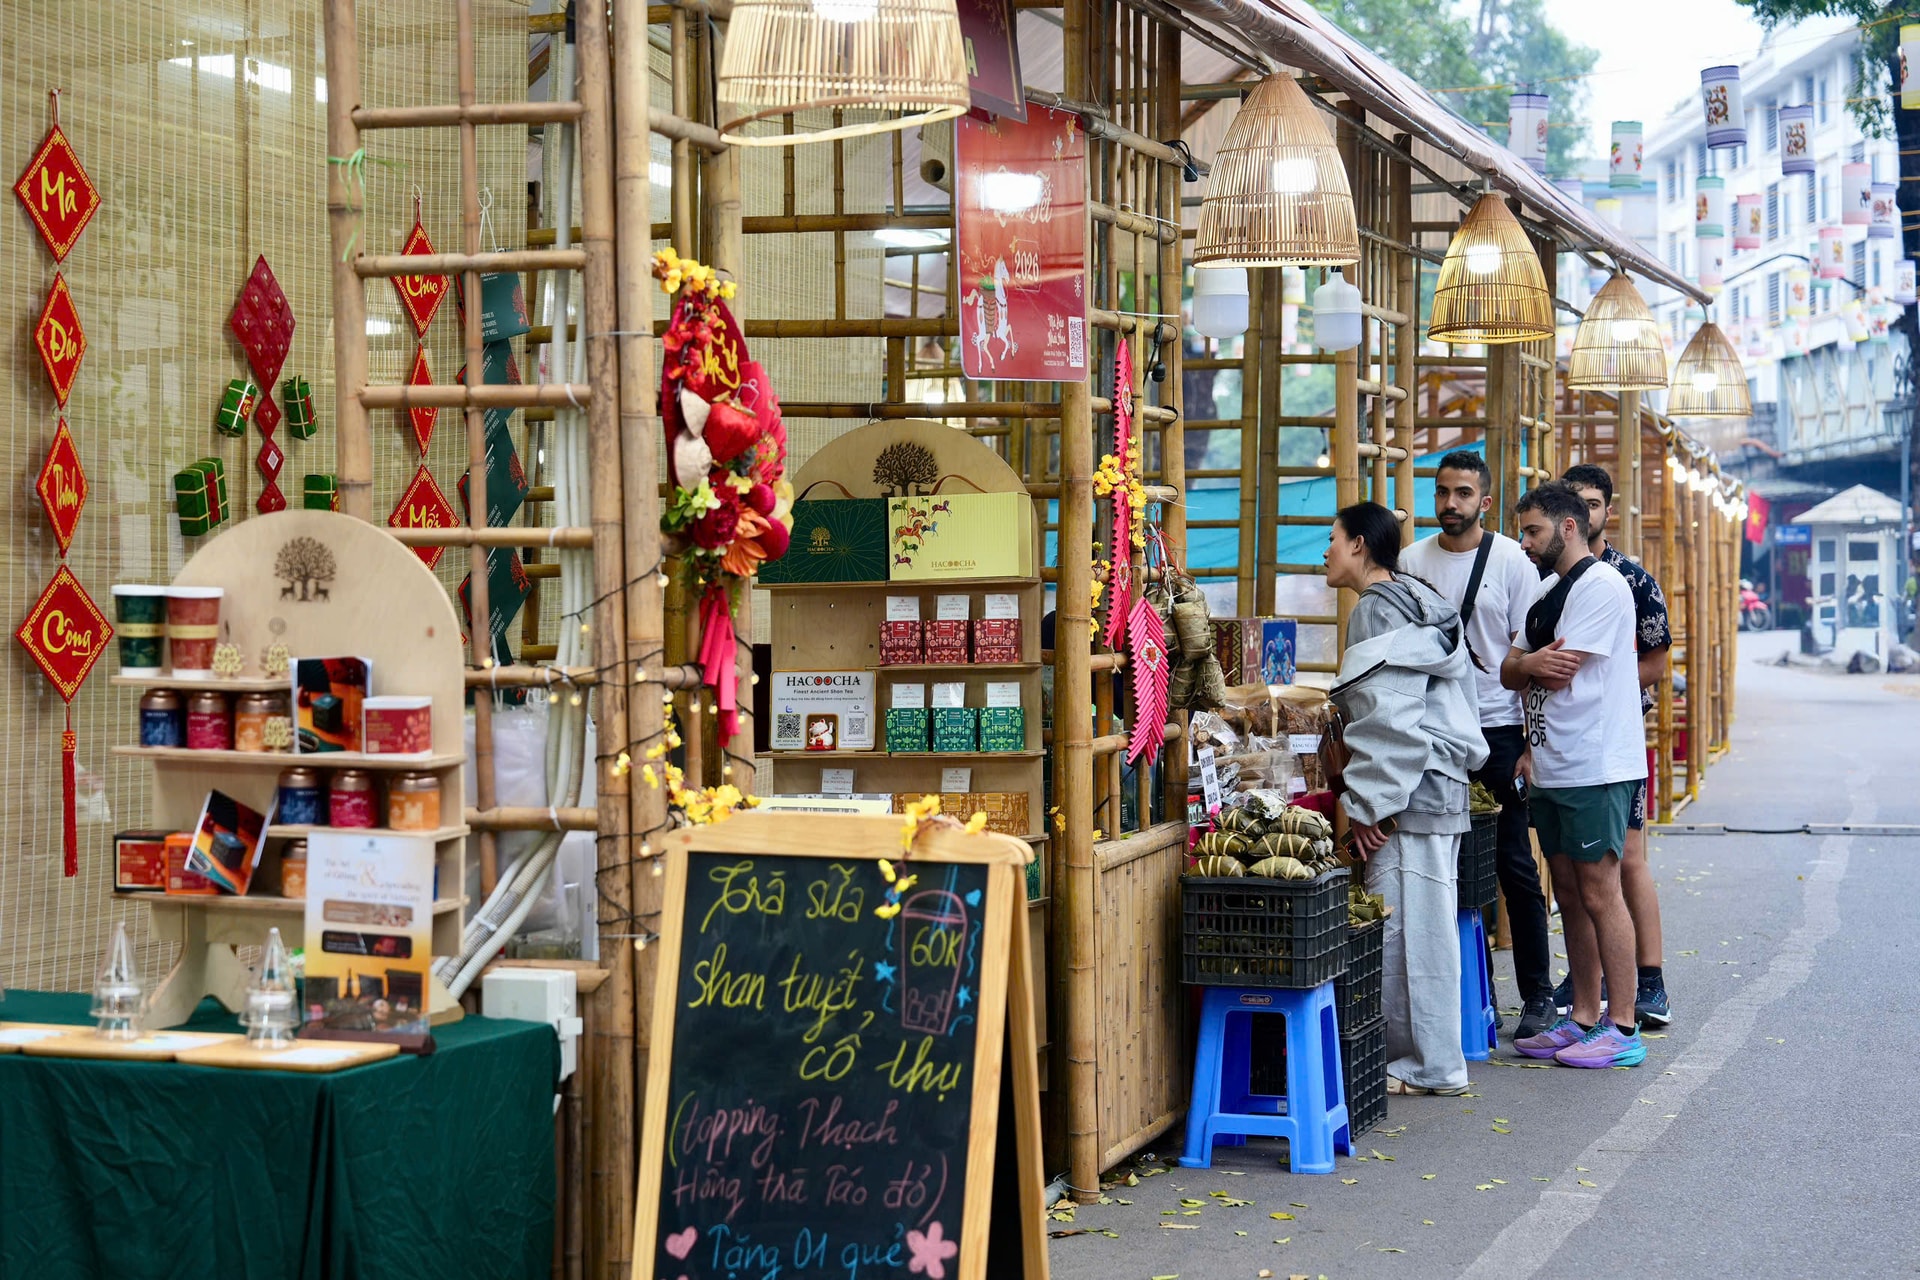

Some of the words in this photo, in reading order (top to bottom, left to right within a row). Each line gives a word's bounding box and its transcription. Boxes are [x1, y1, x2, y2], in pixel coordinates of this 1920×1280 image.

[41, 166, 78, 222] Mã
[1014, 250, 1040, 282] 2026
[49, 317, 77, 363] Đáo
[931, 560, 977, 568] HACOOCHA
[42, 609, 93, 657] Công
[786, 676, 861, 687] HACOOCHA
[1527, 693, 1548, 711] JOY
[1530, 730, 1547, 747] OP
[806, 863, 865, 922] sữa
[910, 927, 963, 967] 60K
[778, 948, 865, 1043] tuyết
[799, 1010, 875, 1081] cổ
[875, 1035, 962, 1102] thụ
[798, 1095, 899, 1150] Thạch
[672, 1160, 745, 1222] Hồng
[826, 1164, 868, 1206] Táo
[707, 1223, 783, 1280] Tặng
[794, 1227, 828, 1269] 01
